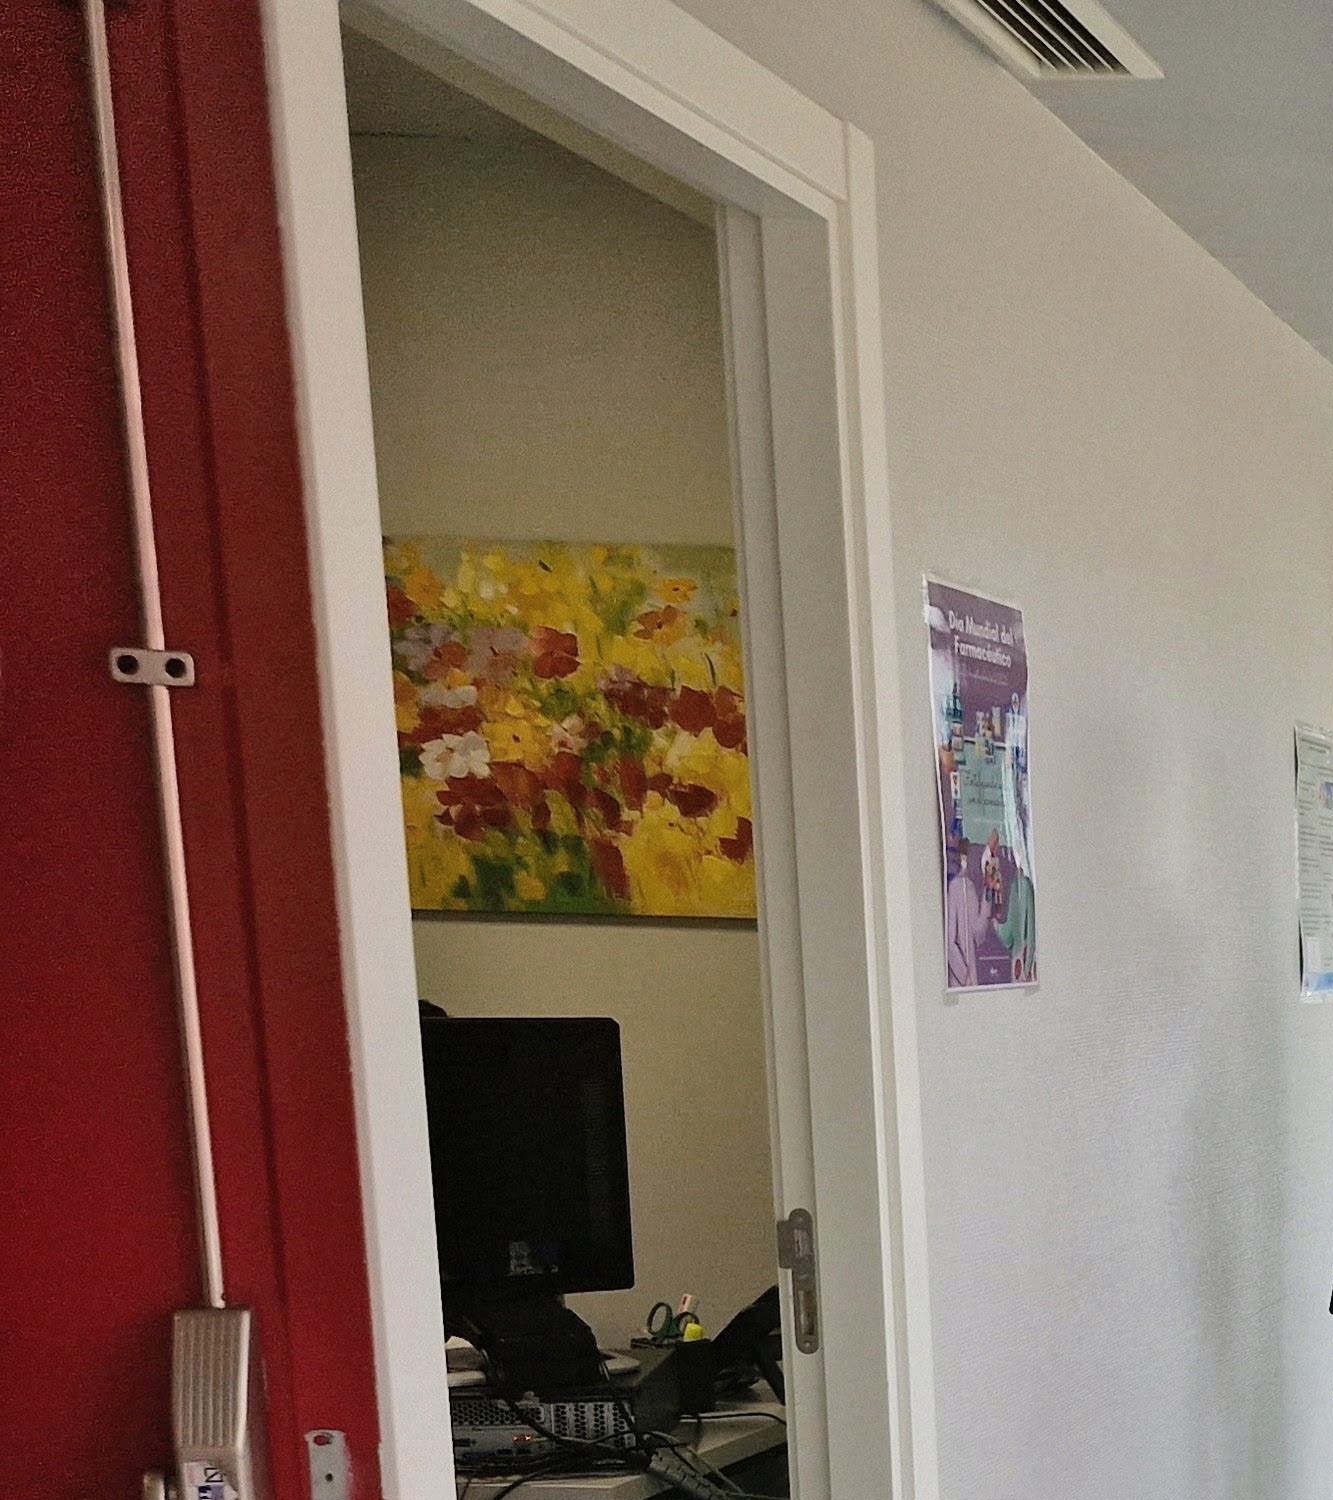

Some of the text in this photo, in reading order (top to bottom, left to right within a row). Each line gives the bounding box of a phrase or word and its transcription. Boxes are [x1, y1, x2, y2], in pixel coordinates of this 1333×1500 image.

[965, 614, 1000, 643] Mundial
[1001, 624, 1014, 647] del
[954, 634, 1011, 668] Farmacéutico
